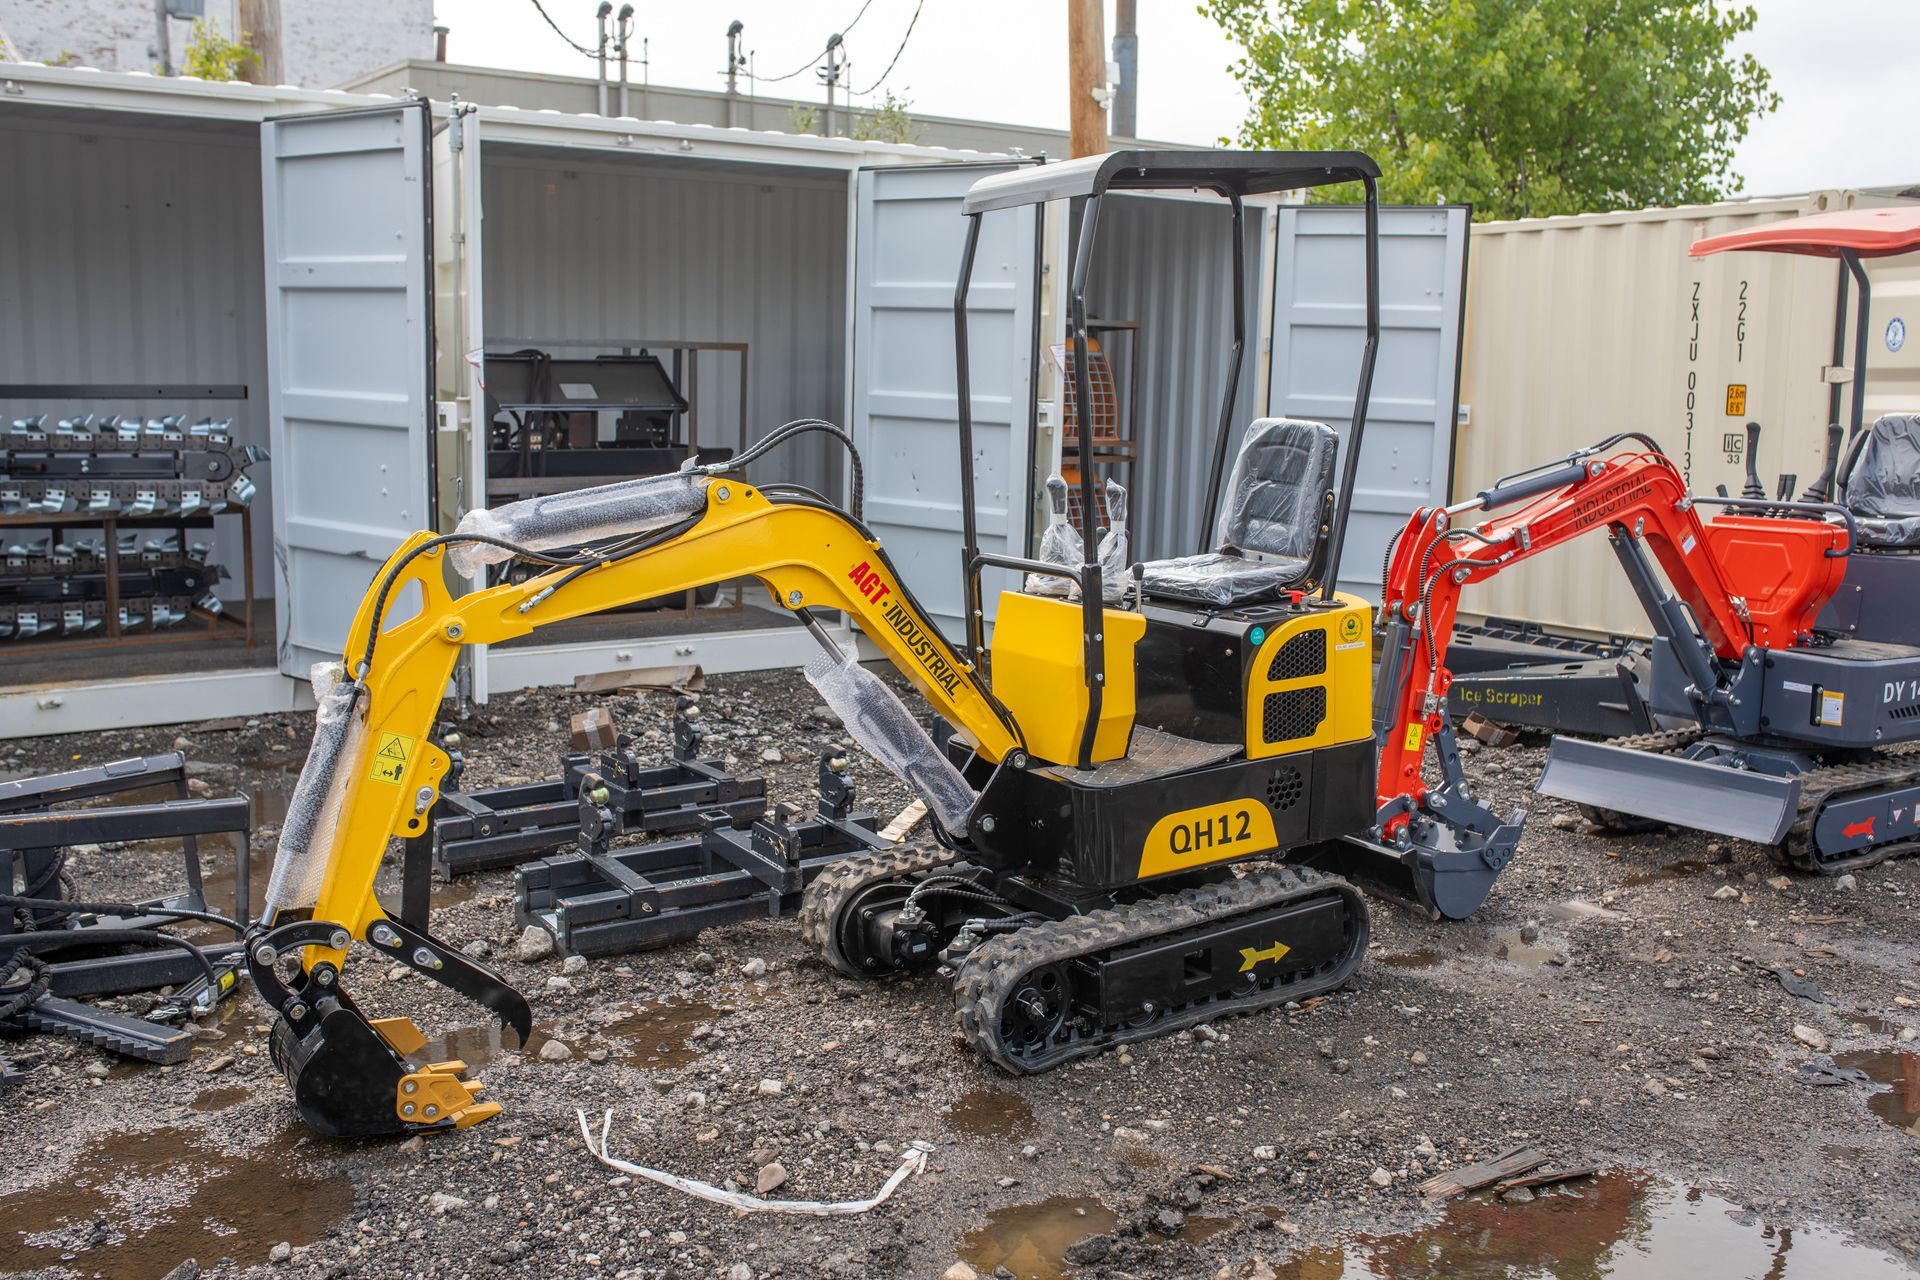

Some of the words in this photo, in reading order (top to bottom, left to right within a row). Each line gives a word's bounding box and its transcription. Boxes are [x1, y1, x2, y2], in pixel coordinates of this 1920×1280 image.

[1689, 282, 1701, 362] ZXJU
[1737, 281, 1748, 362] 22G1
[1727, 454, 1740, 464] 33
[1573, 474, 1652, 528] INDUSTRIAL
[848, 561, 890, 605] AGT
[885, 605, 960, 696] INDUSTRIAL
[1461, 687, 1482, 702] Ice
[1486, 688, 1542, 707] Scraper
[1883, 681, 1906, 703] DY
[1170, 811, 1251, 854] QH12
